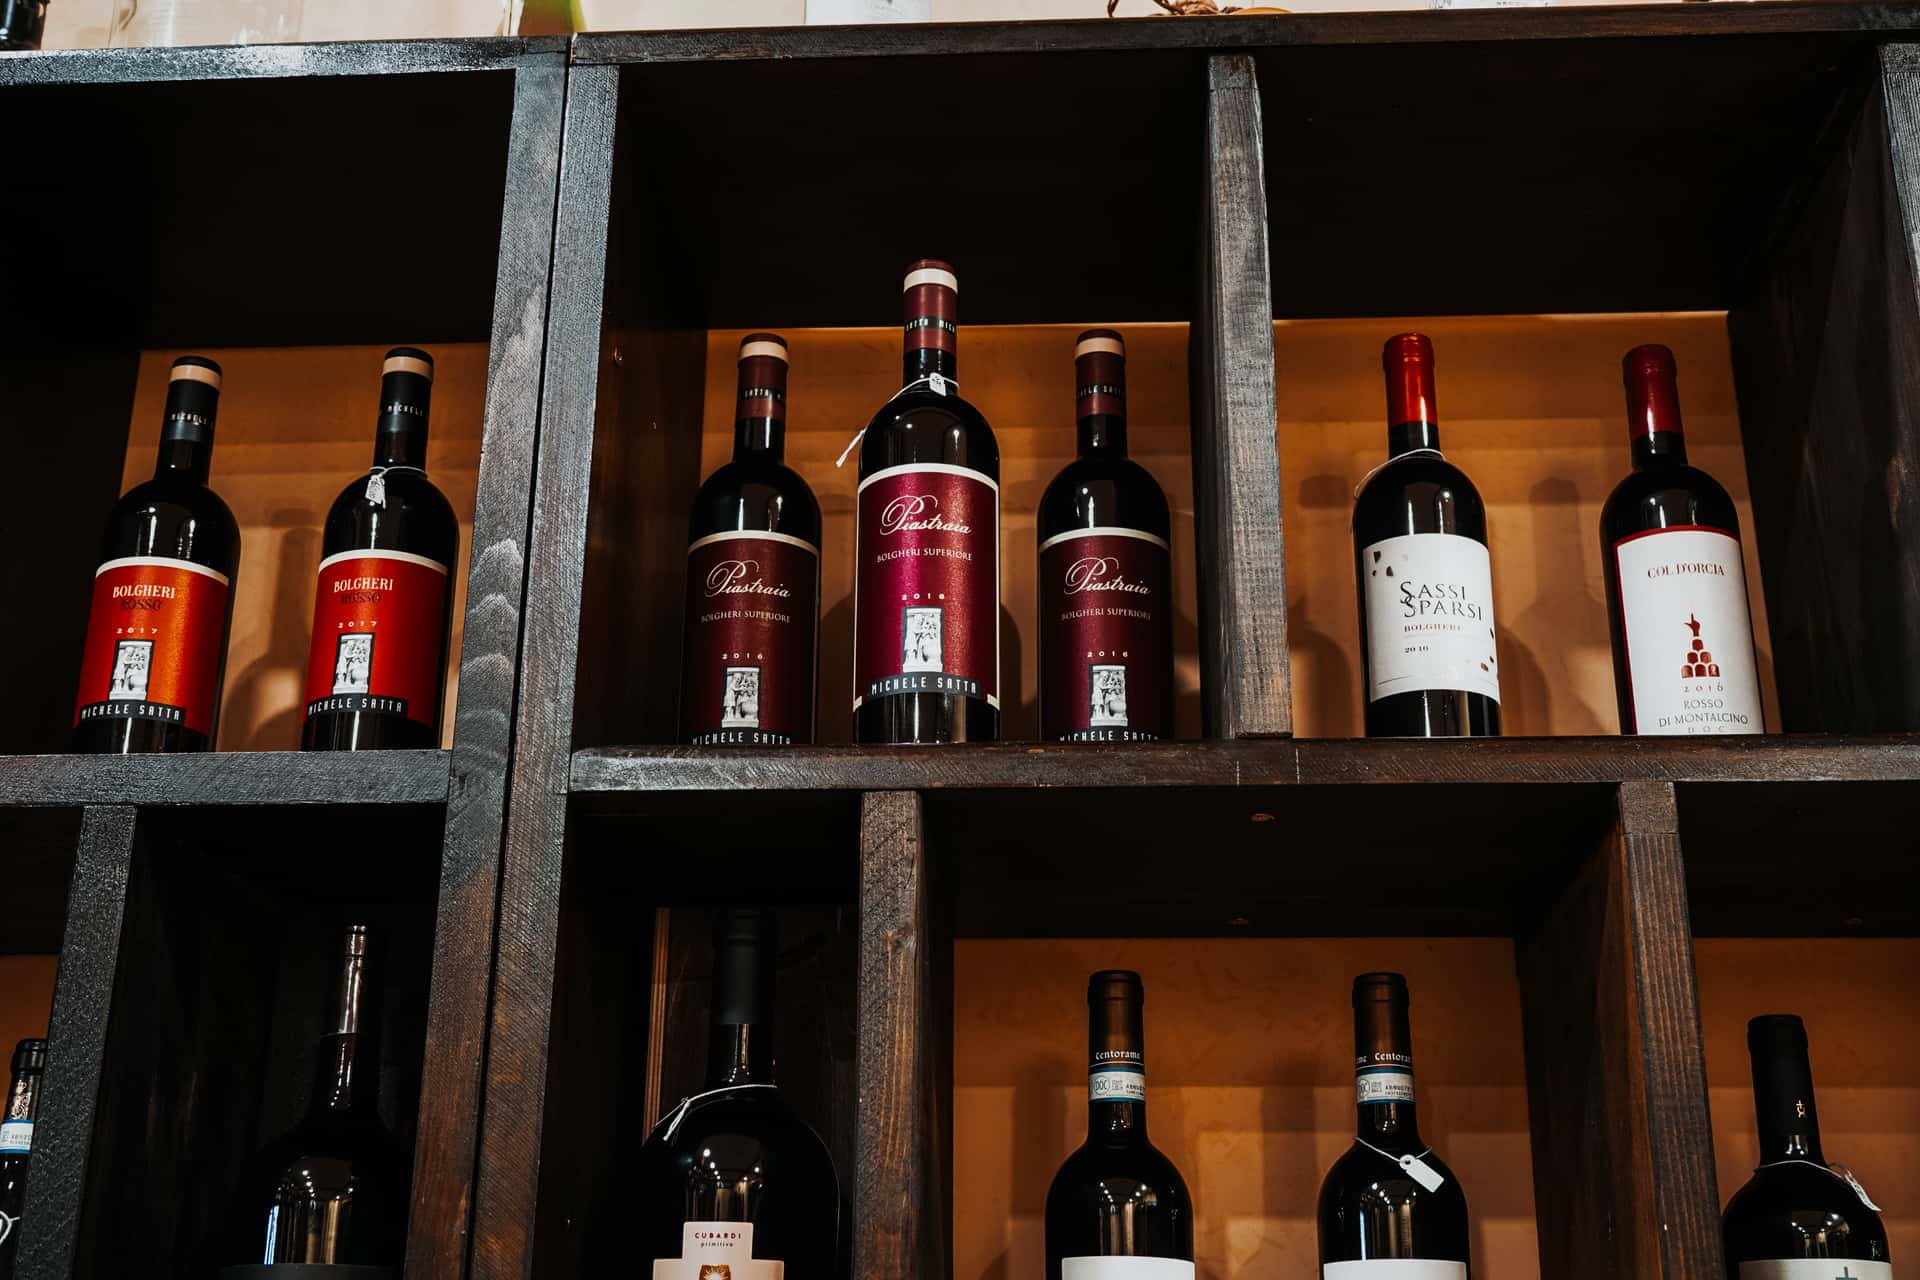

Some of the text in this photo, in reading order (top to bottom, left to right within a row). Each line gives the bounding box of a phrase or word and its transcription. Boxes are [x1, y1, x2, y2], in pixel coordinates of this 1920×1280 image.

[880, 494, 972, 536] Piastraia
[877, 547, 973, 563] BOLGHERI SUPERIORE
[1063, 556, 1151, 595] Piastraia
[1647, 562, 1725, 579] COL D'ORCIA
[334, 577, 394, 593] BOLGHERI
[704, 559, 791, 598] Piastraia
[112, 585, 176, 599] BOLGHERI
[340, 592, 382, 606] ROSSO
[901, 593, 945, 601] 2016
[1400, 580, 1466, 604] SASSI
[120, 599, 162, 611] ROSSO
[1404, 595, 1482, 621] SPARSI
[701, 610, 791, 623] BOLGHERI SUPERIORE
[1061, 607, 1151, 622] BOLGHERI SUPERIORE
[338, 620, 378, 628] 2017
[1404, 623, 1461, 633] BOLGHERI
[721, 652, 764, 661] 2016
[1087, 650, 1129, 658] 2016
[871, 676, 977, 695] MICHELE SATTA
[1683, 681, 1724, 693] 2016
[308, 698, 402, 716] MICHELE SATTA
[1683, 698, 1724, 710] ROSSO
[81, 704, 180, 721] MICHELE SATTA
[1658, 711, 1749, 729] DI MONTALCINO
[692, 731, 745, 746] MICHELE
[1095, 1050, 1142, 1060] Centorame
[694, 1232, 742, 1240] CUBARDI
[700, 1240, 735, 1249] primitivo
